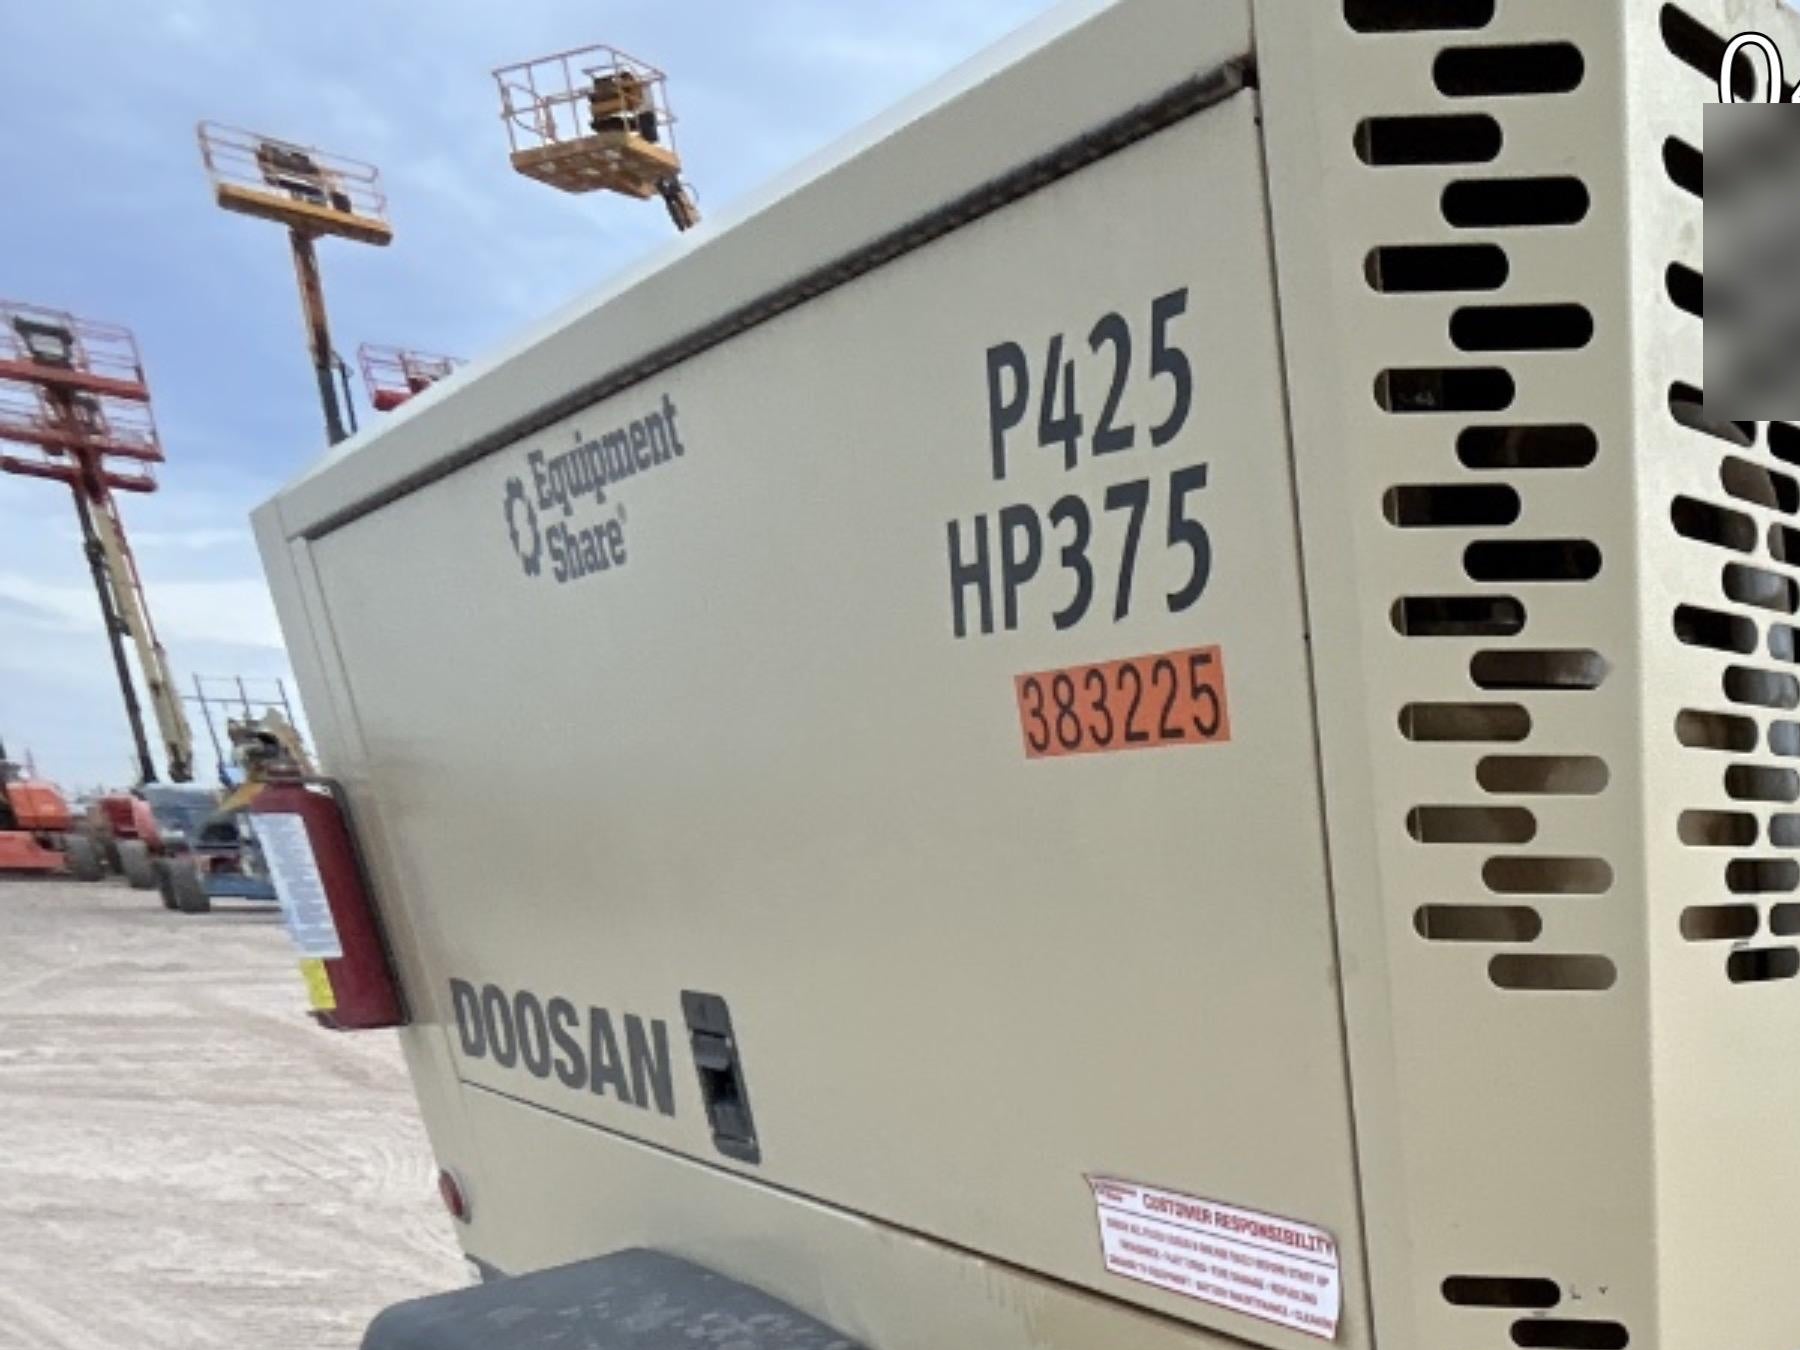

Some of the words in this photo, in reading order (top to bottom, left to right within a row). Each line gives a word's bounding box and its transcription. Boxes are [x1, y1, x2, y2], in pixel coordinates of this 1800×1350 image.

[986, 287, 1193, 480] P425
[527, 391, 685, 517] Equipment
[545, 517, 628, 583] Share
[946, 462, 1212, 639] HP375
[1022, 653, 1220, 753] 383225
[449, 977, 676, 1117] DOOSAN
[1142, 1193, 1213, 1225] CUSTOMER
[1214, 1211, 1335, 1256] RESPONSIBILITY
